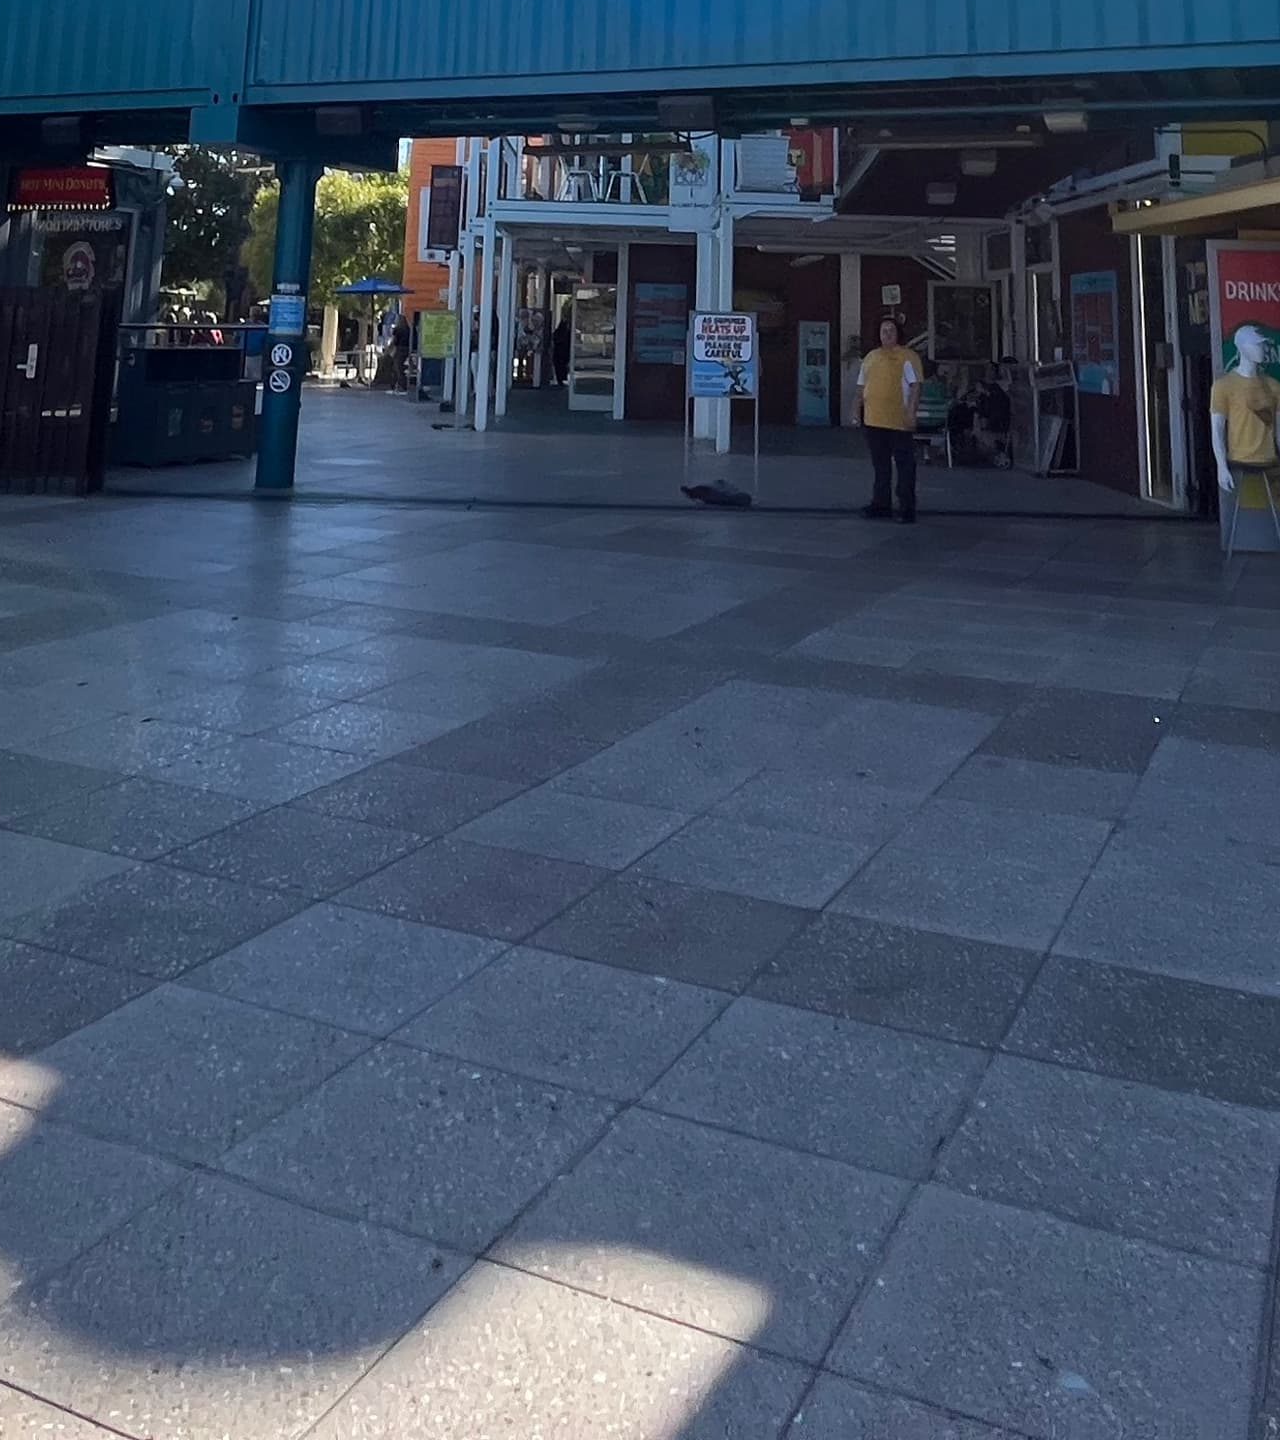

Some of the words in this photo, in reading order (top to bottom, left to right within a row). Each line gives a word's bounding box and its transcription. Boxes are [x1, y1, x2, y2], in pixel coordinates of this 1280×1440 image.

[702, 323, 731, 334] HEATS
[733, 325, 746, 335] UP
[705, 349, 743, 358] CAREFUL
